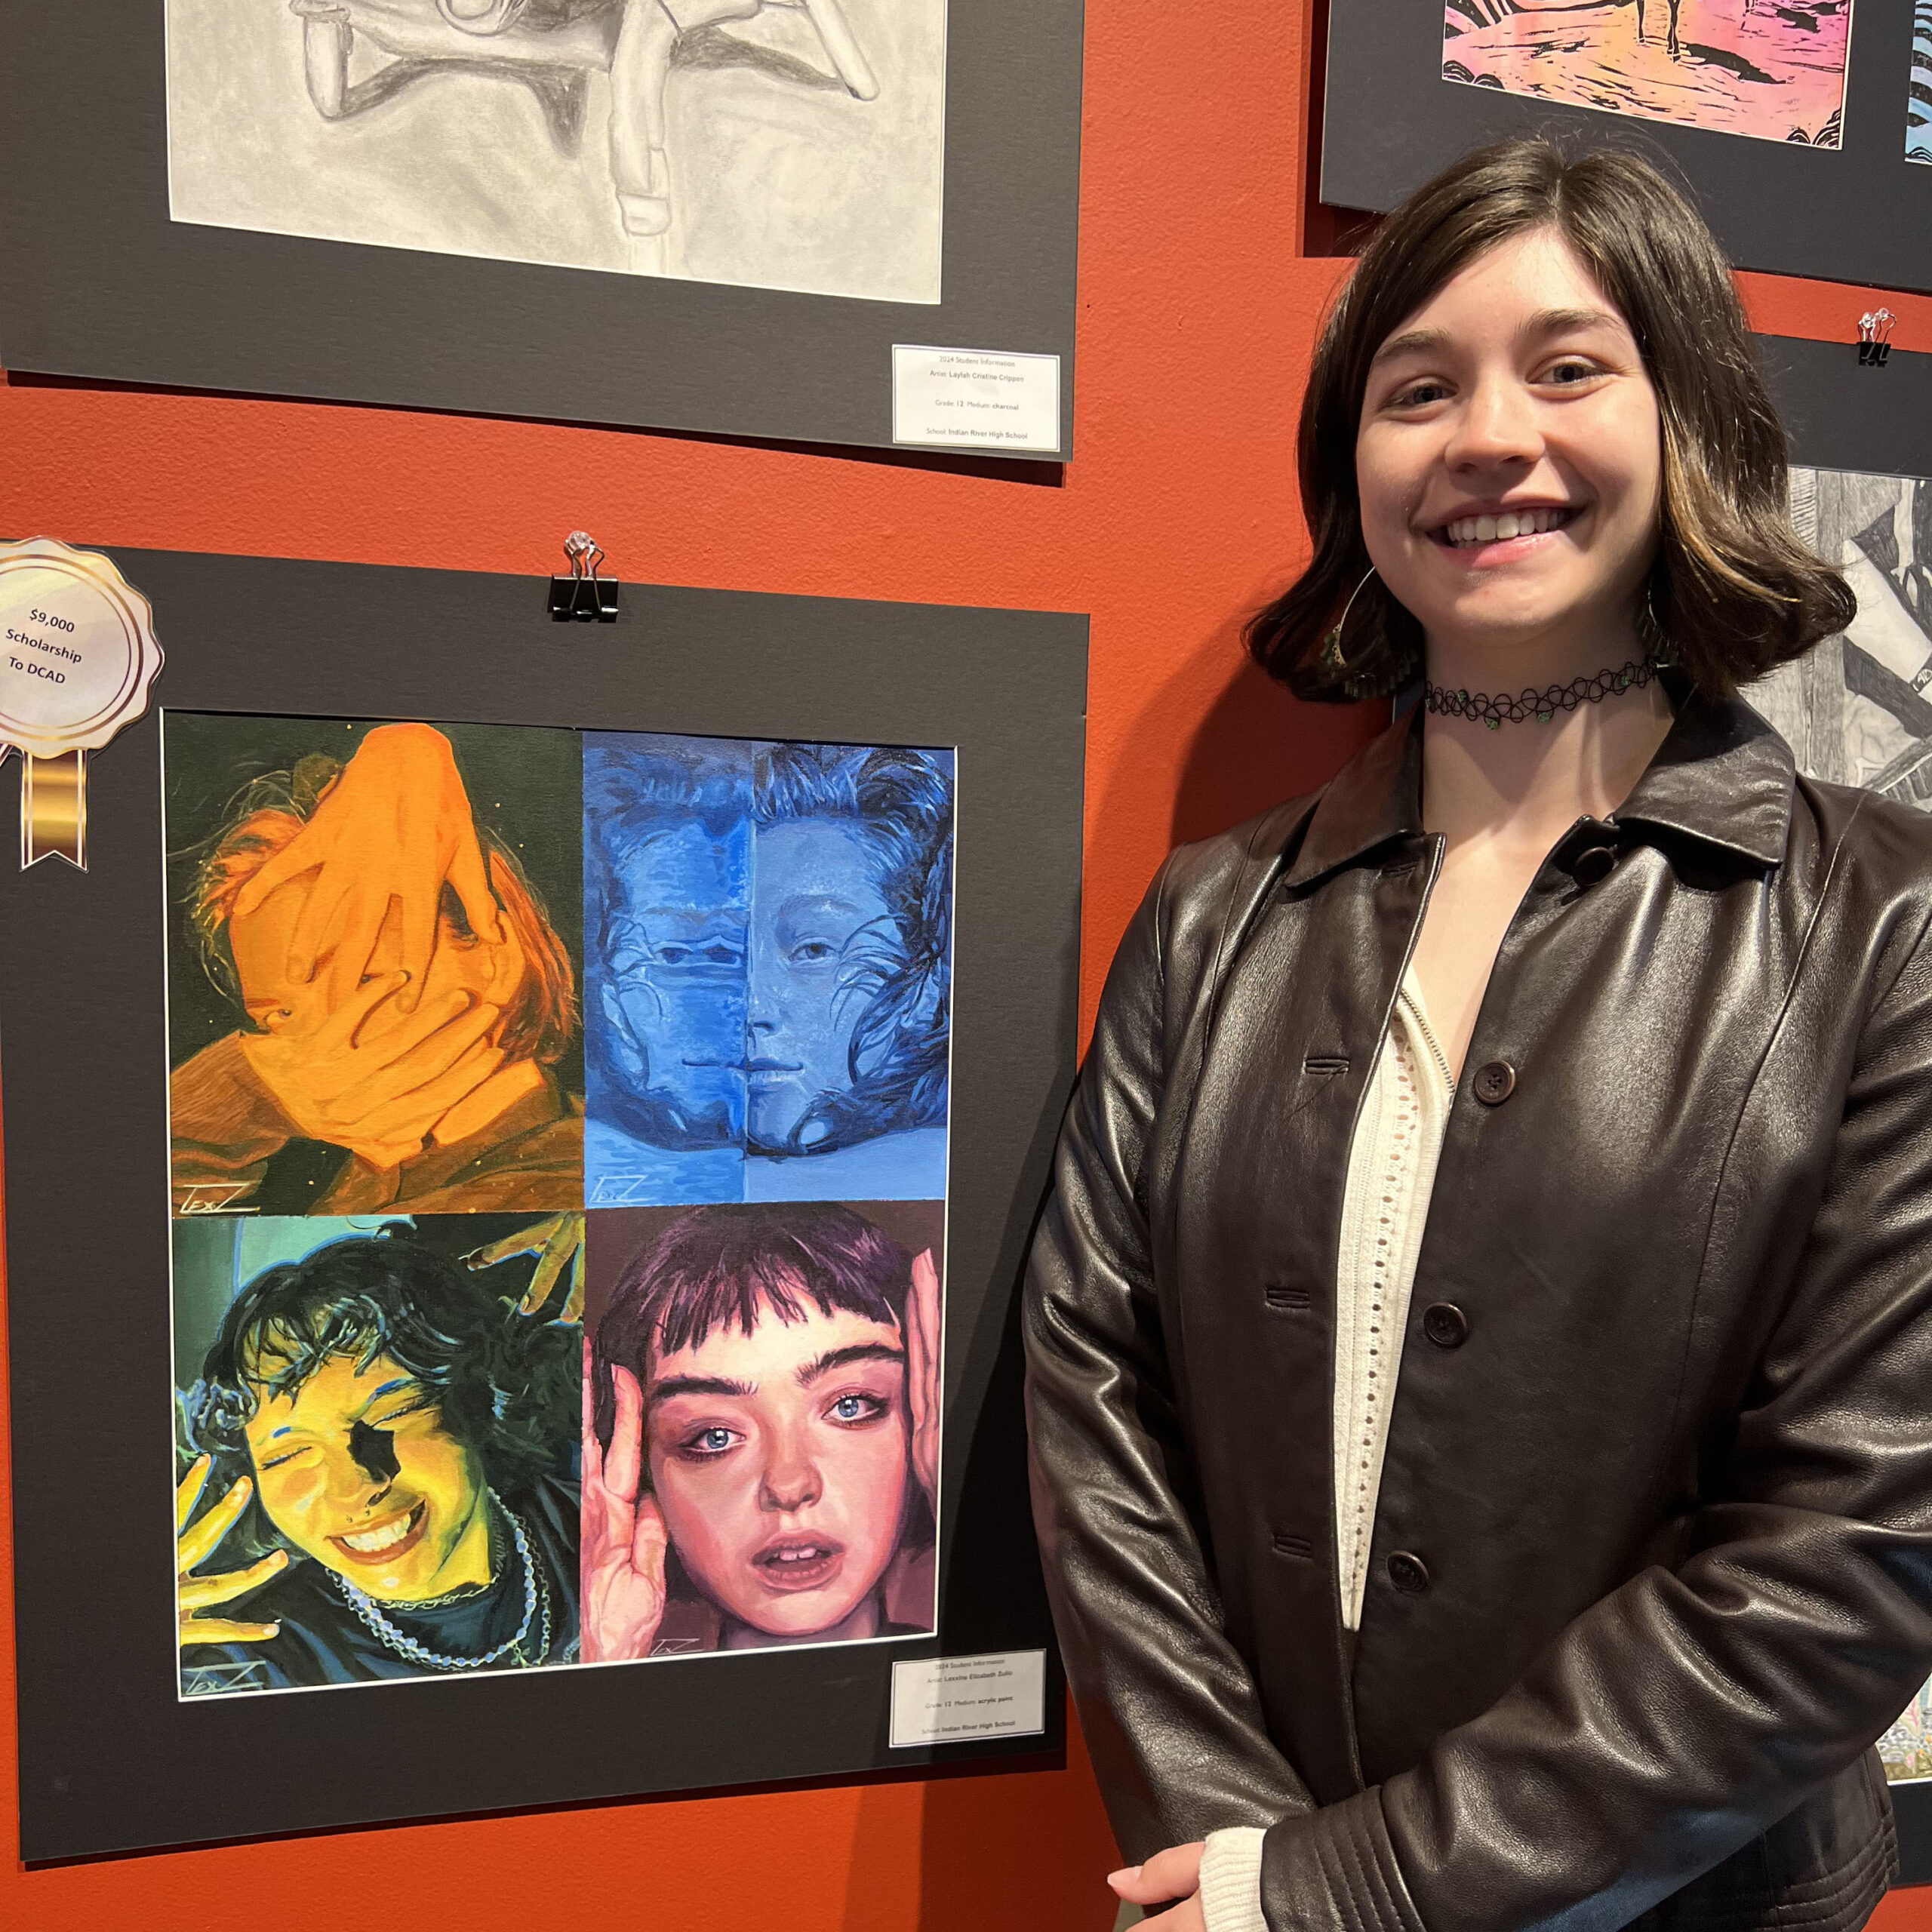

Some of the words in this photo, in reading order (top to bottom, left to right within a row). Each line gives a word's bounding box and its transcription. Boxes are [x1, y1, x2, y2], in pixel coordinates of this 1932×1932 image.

[956, 356, 979, 365] Student
[980, 358, 1016, 367] Information
[949, 371, 971, 379] Laylah
[972, 372, 998, 380] Cristine
[989, 431, 1004, 439] High
[29, 608, 75, 632] $9,000
[6, 629, 82, 664] Scholarship
[9, 656, 24, 670] To
[27, 663, 66, 684] DCAD
